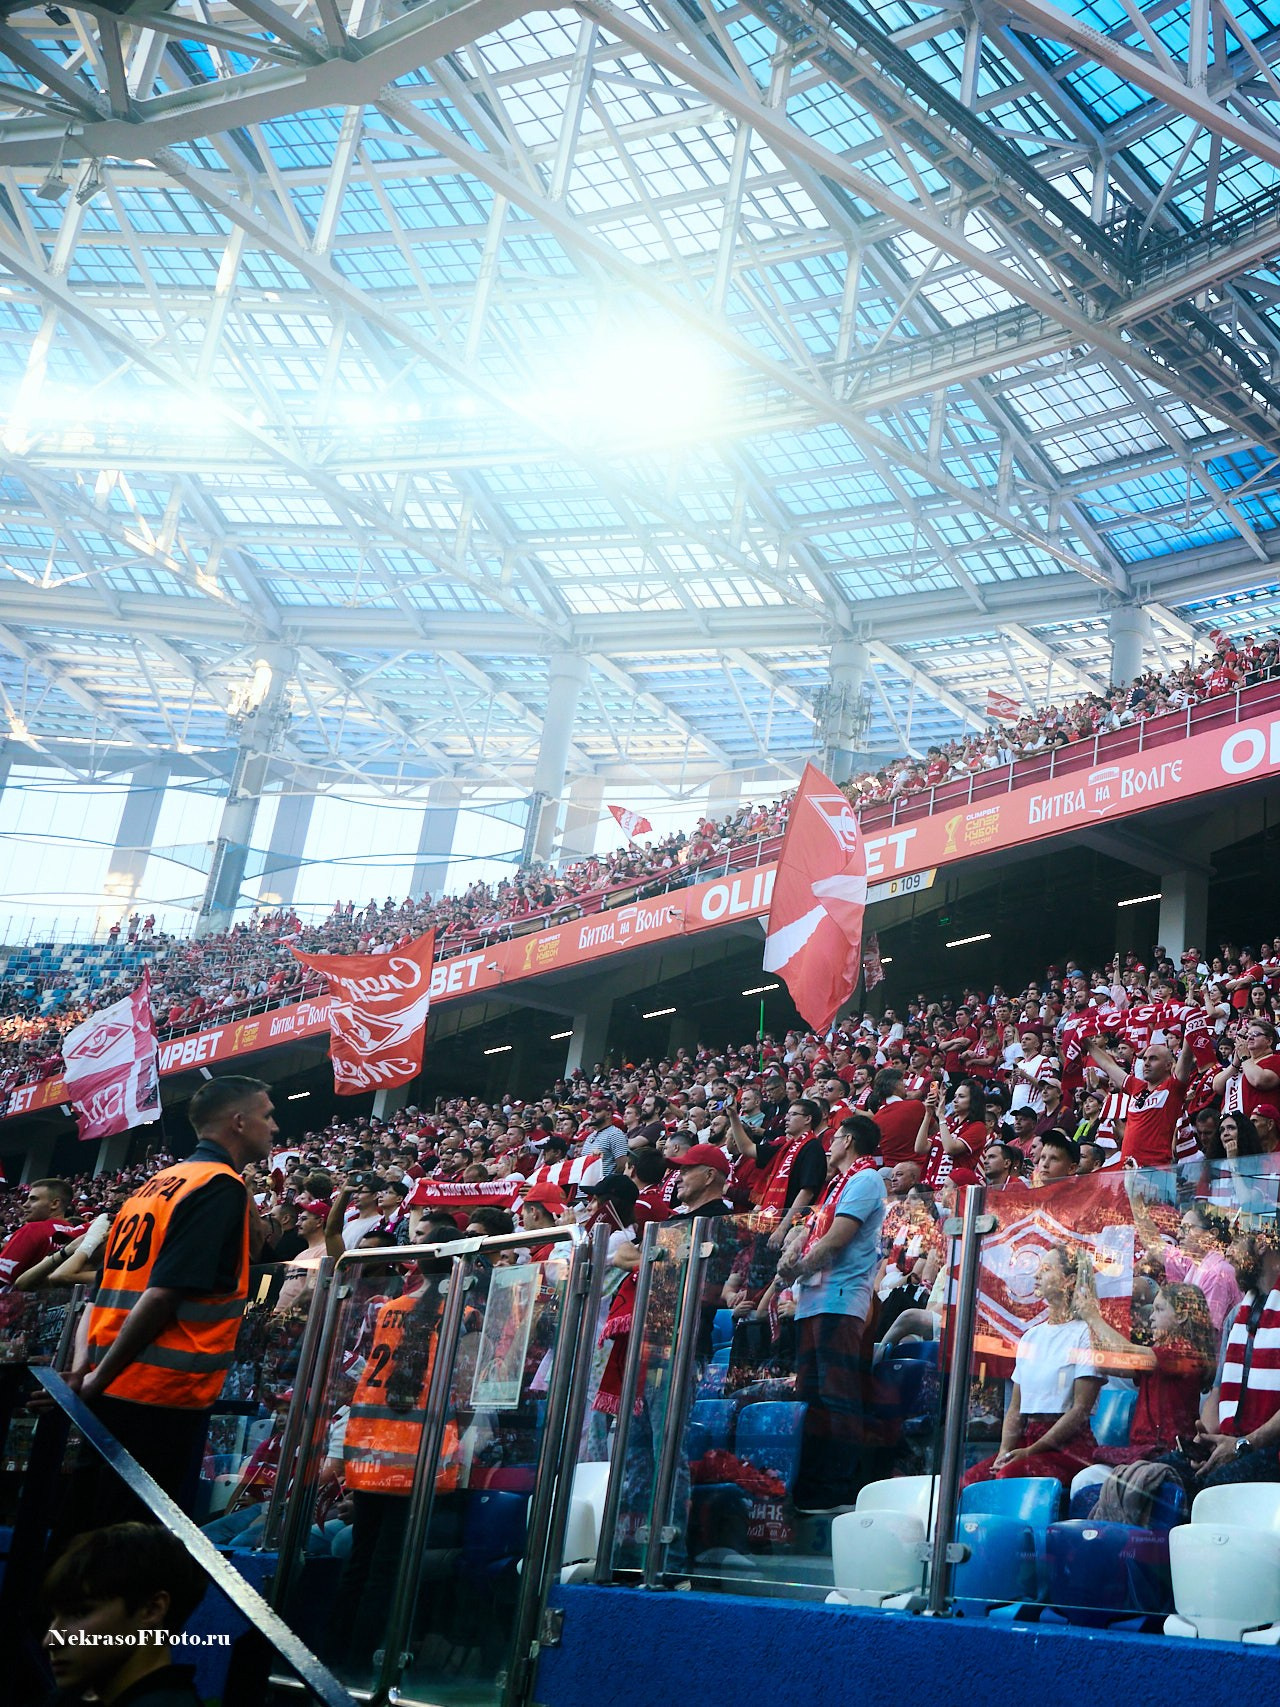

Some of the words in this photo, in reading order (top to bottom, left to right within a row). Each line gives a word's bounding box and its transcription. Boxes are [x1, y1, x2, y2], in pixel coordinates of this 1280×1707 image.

[966, 806, 1000, 821] OLIMPBET
[891, 882, 897, 893] D
[901, 875, 921, 891] 109
